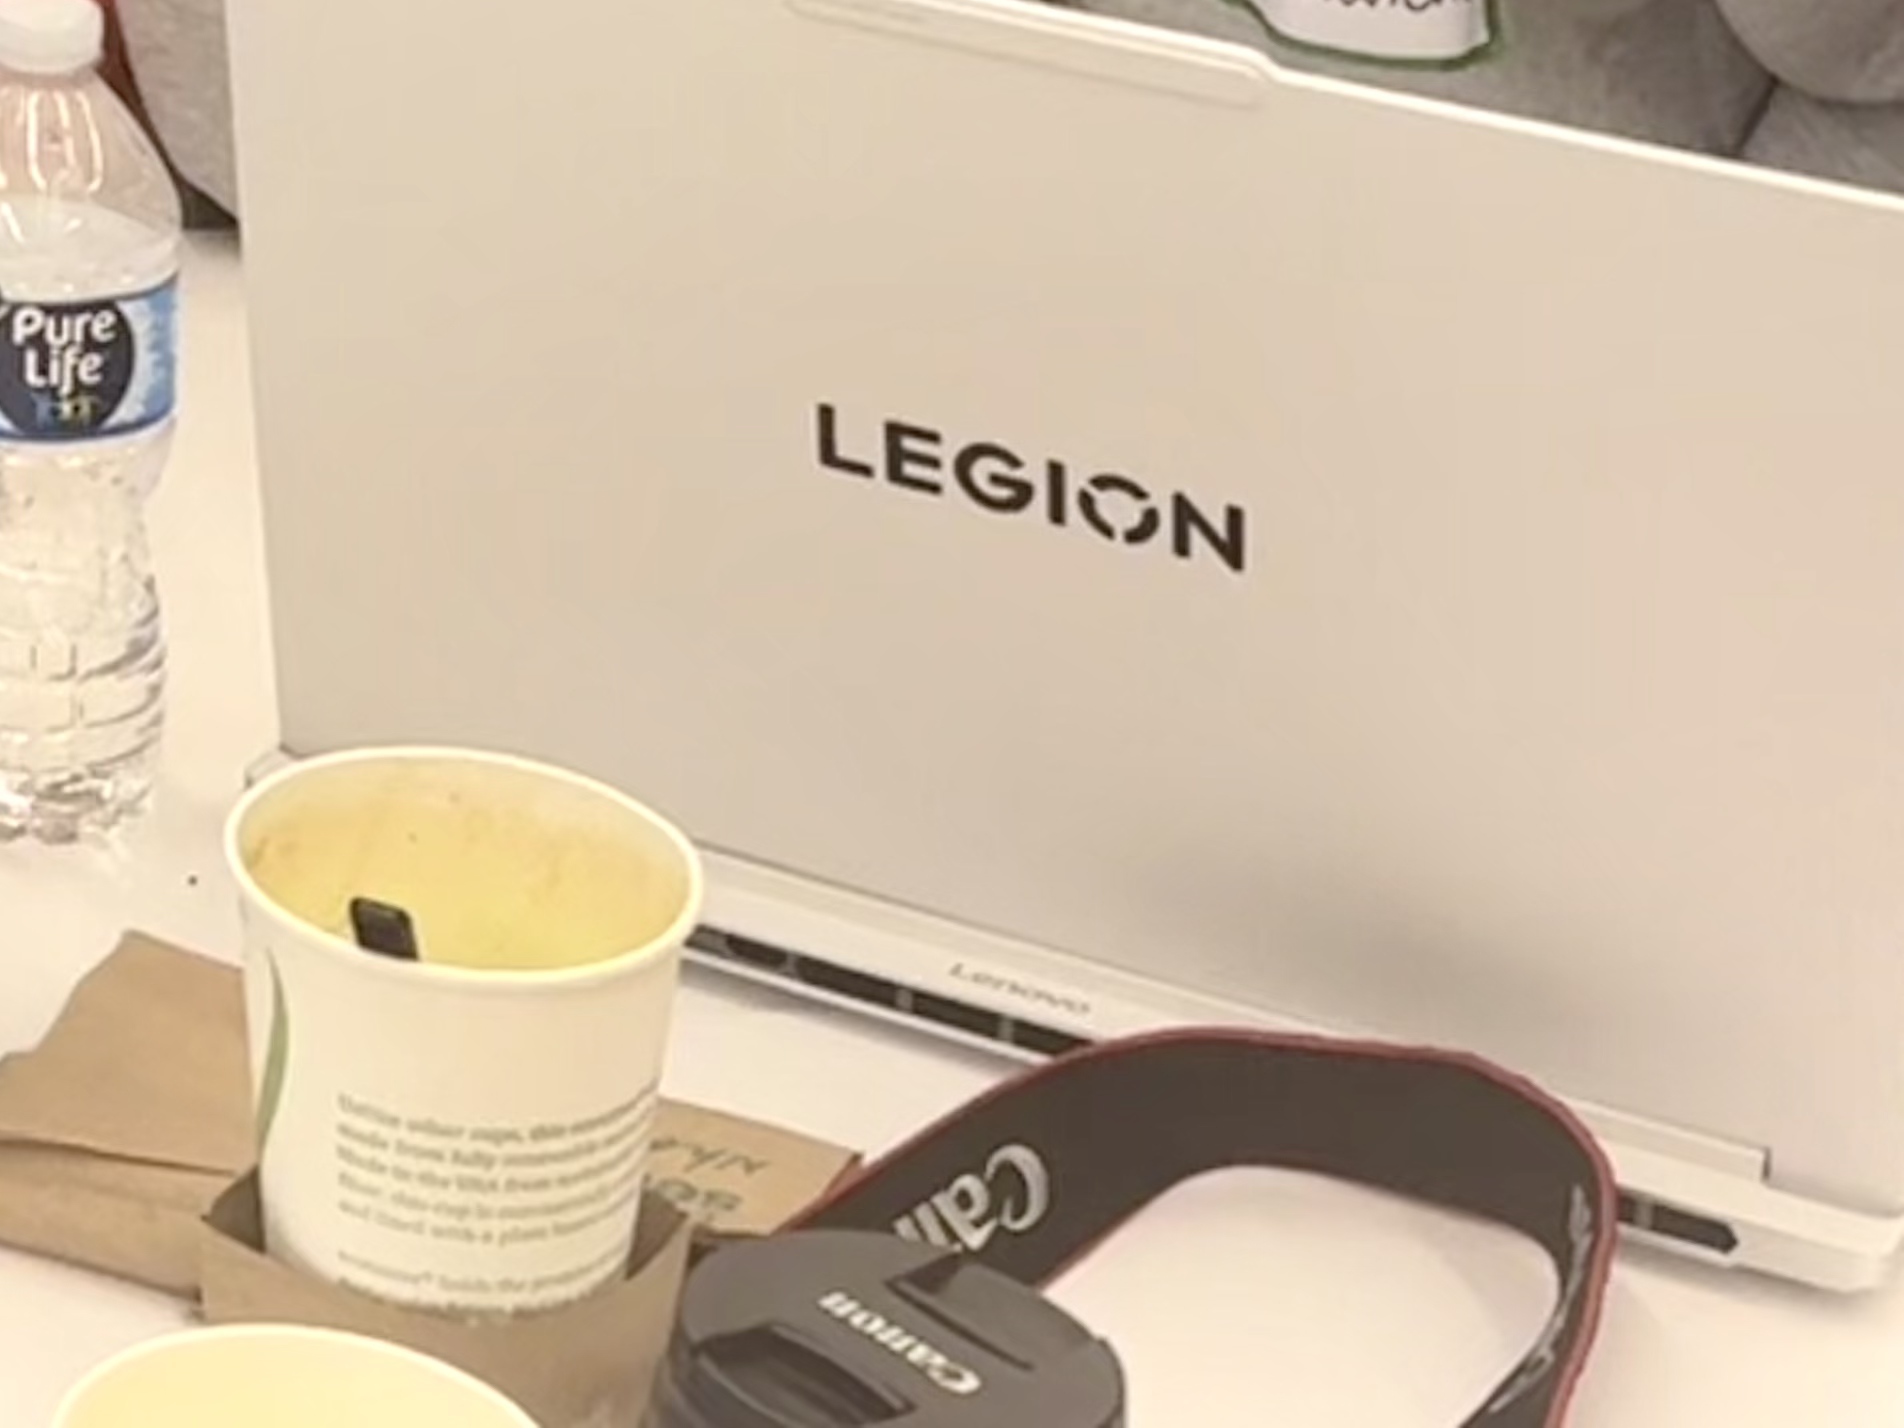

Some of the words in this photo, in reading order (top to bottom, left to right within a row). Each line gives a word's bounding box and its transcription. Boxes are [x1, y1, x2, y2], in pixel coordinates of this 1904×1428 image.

[12, 306, 118, 346] Pure
[24, 344, 104, 396] Life
[816, 401, 1245, 573] LEGION
[816, 1290, 983, 1396] Canon
